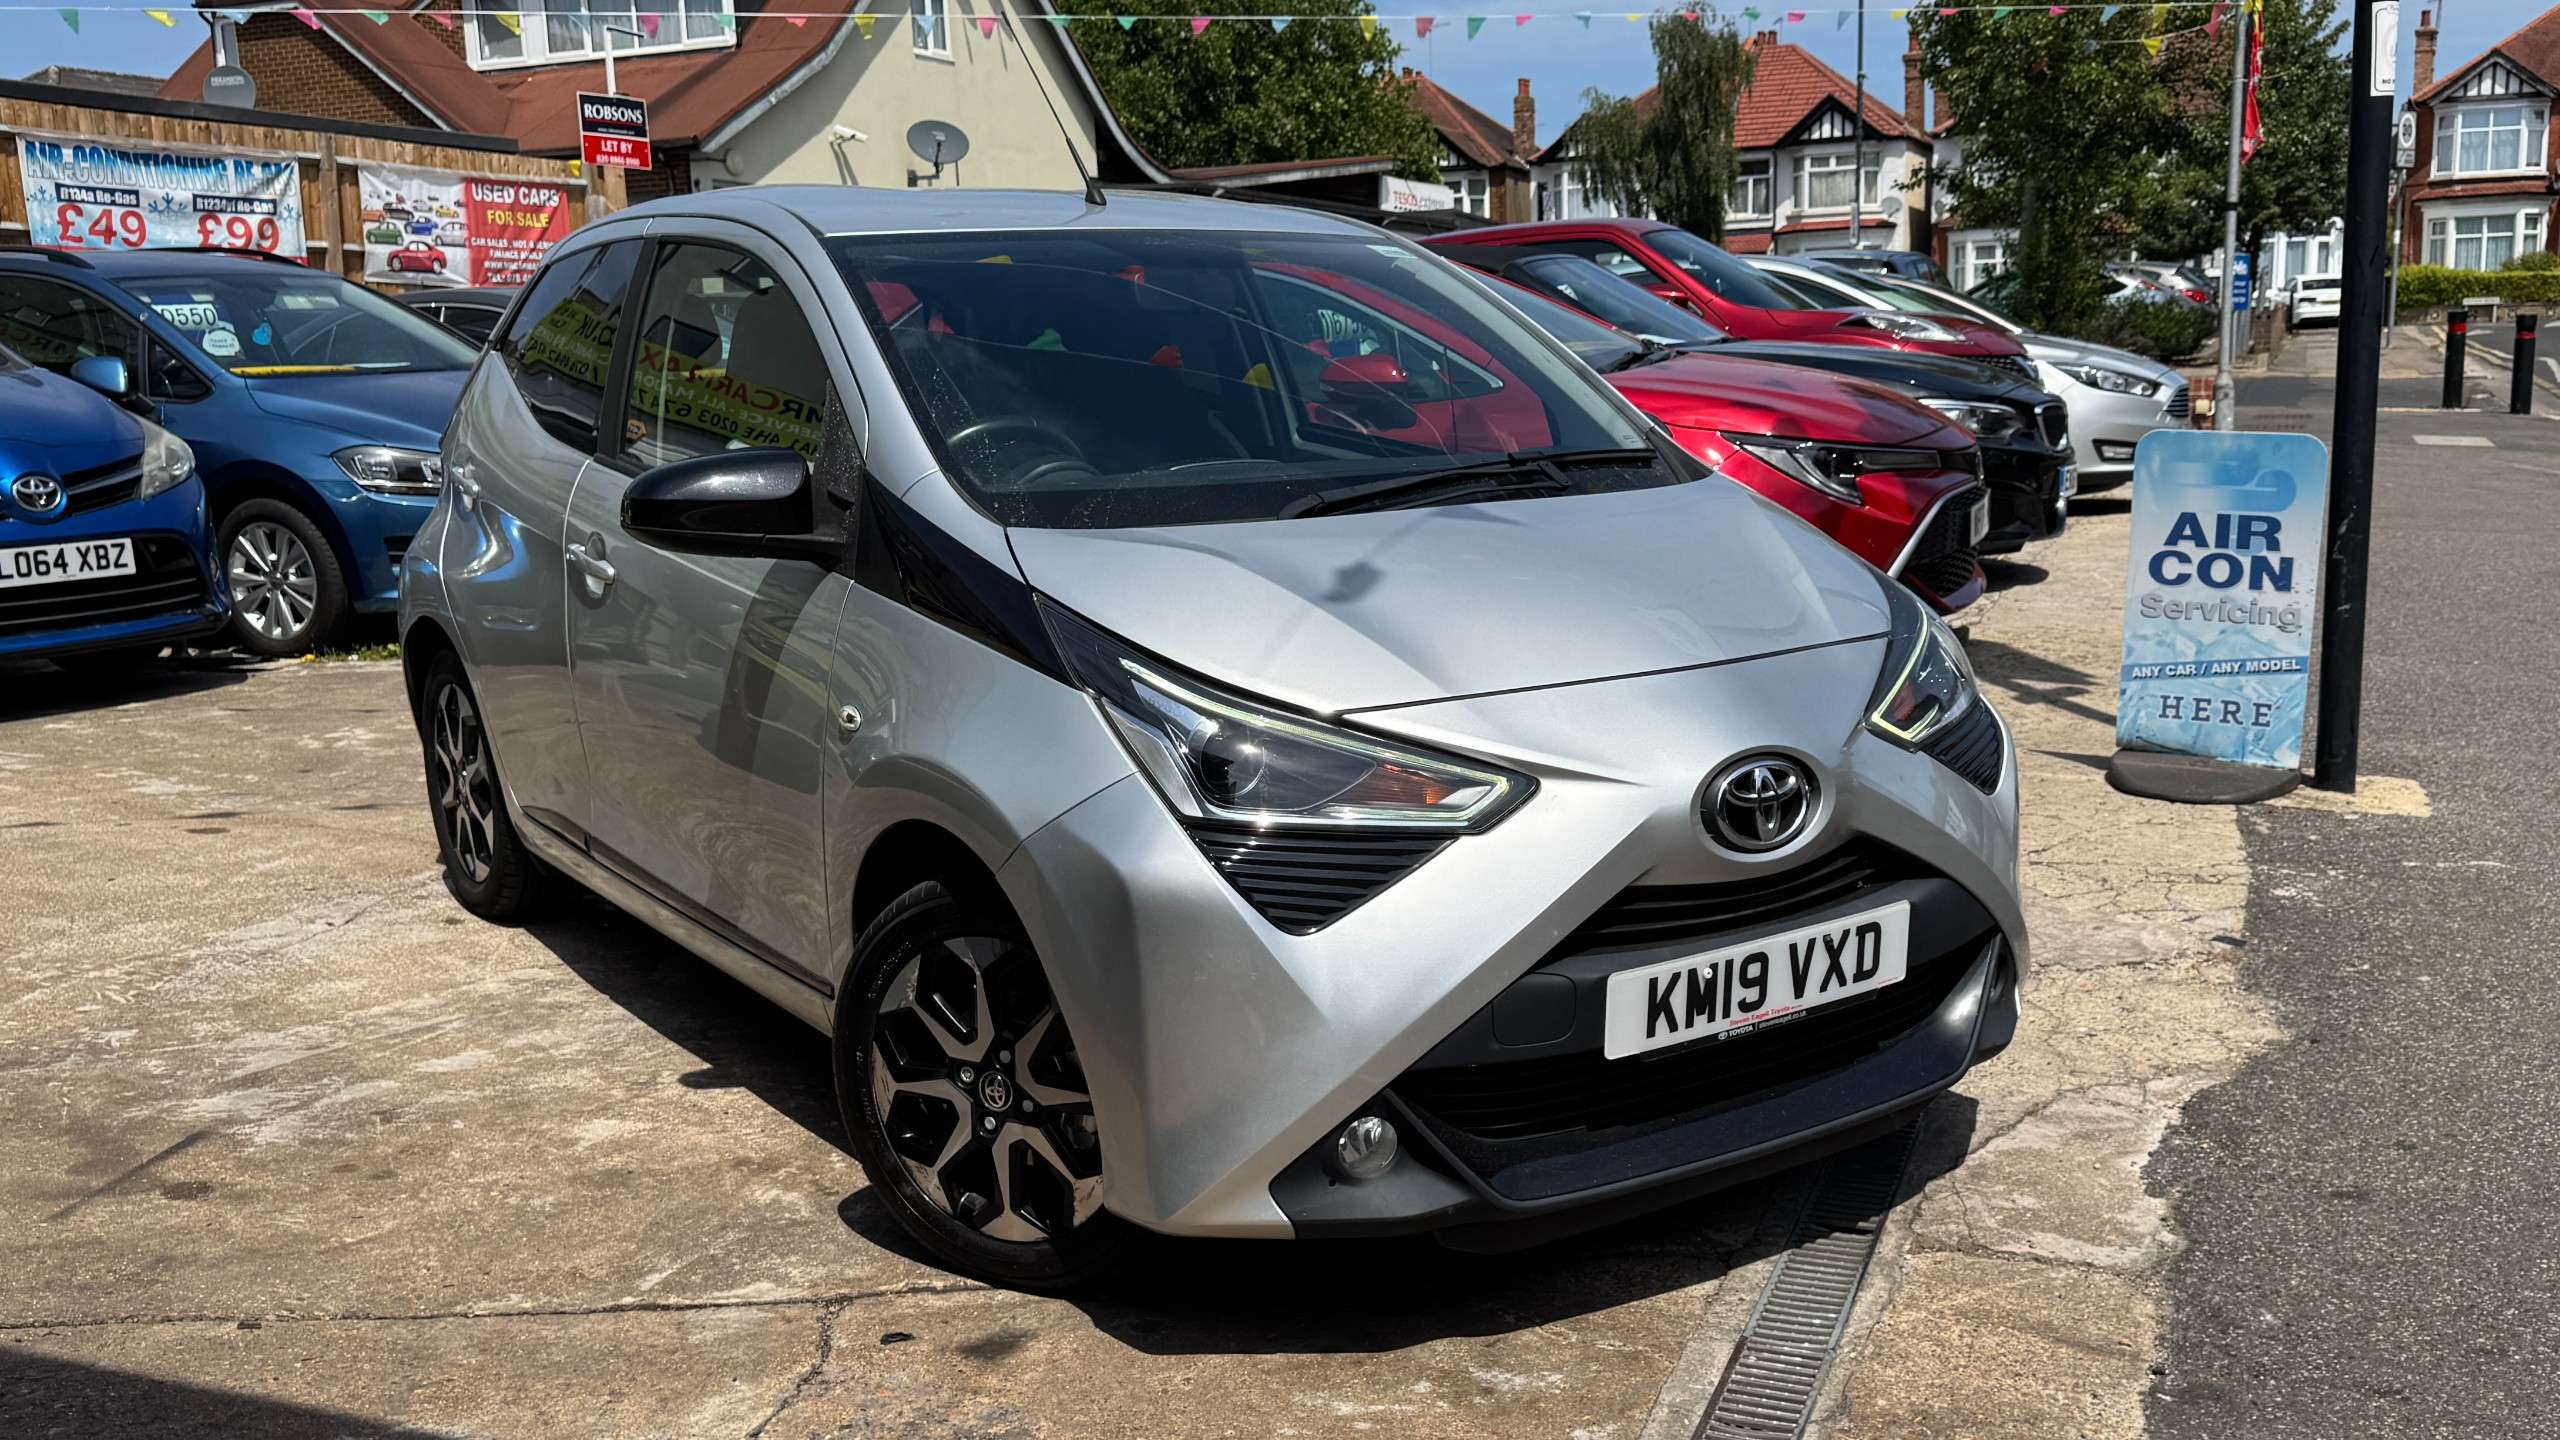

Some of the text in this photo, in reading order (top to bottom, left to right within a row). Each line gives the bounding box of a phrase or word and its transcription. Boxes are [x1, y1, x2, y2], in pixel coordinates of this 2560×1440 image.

[583, 103, 643, 124] ROBSONS
[601, 139, 633, 154] LET BY
[25, 140, 230, 193] AIR-CONDITIONING
[95, 189, 137, 205] Re-Gas
[472, 183, 560, 208] USED CARS
[56, 203, 147, 248] £49
[197, 212, 280, 252] £99
[487, 209, 550, 228] FOR SALE
[2163, 511, 2282, 552] AIR
[76, 542, 129, 573] XBZ
[2148, 550, 2295, 592] CON
[2140, 593, 2301, 633] Servicing
[2131, 666, 2162, 680] ANY
[2165, 664, 2197, 678] CAR
[2211, 661, 2242, 675] ANY
[2246, 658, 2302, 673] MODEL
[2158, 694, 2273, 728] HERE
[1645, 921, 1882, 1040] KM19 VXD
[1729, 1024, 1754, 1037] TOYOTA
